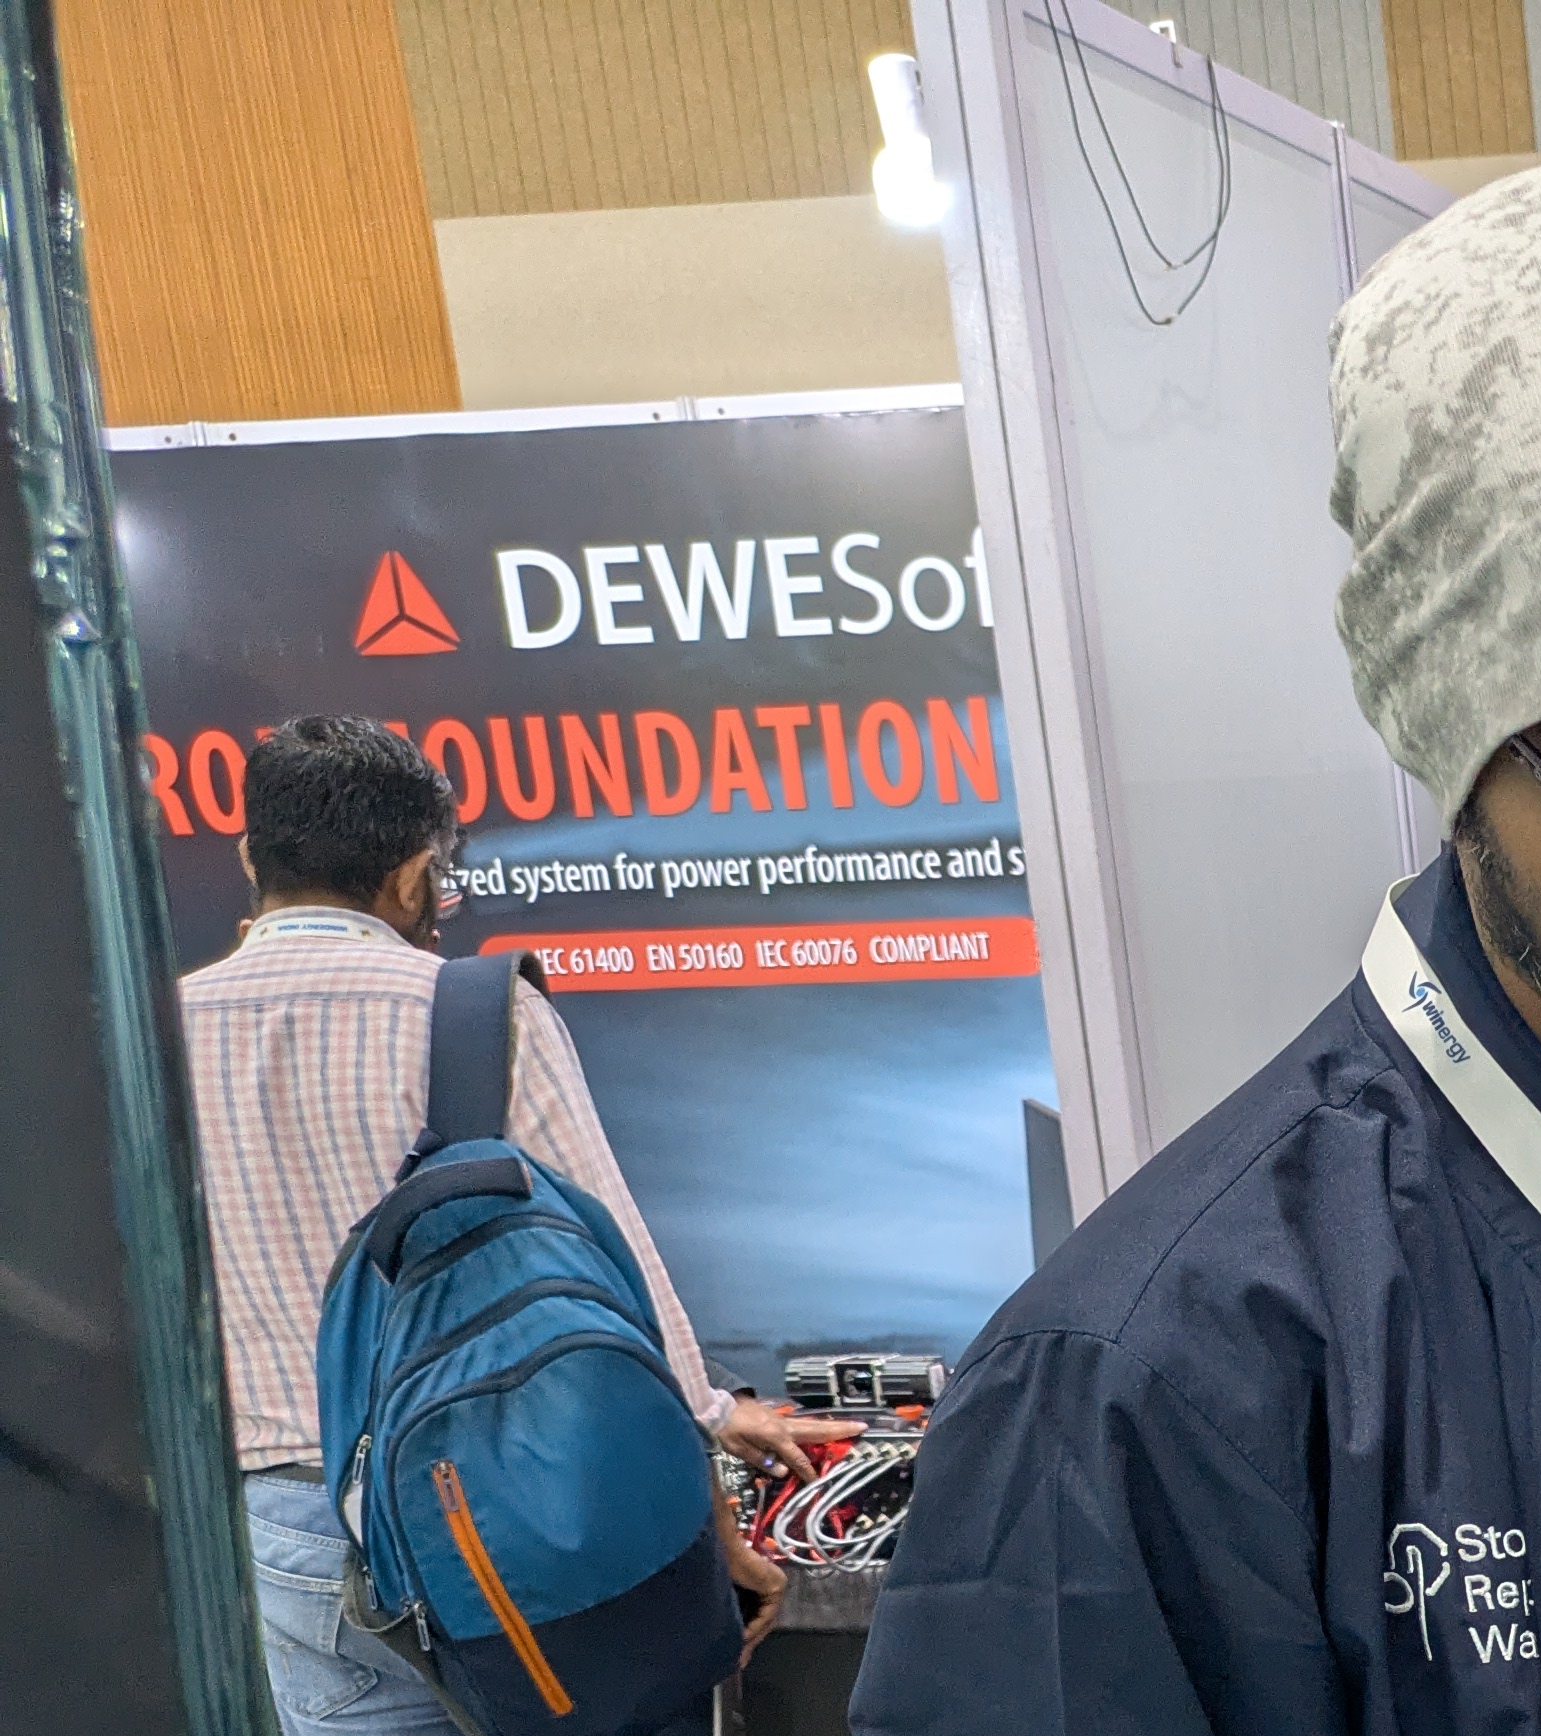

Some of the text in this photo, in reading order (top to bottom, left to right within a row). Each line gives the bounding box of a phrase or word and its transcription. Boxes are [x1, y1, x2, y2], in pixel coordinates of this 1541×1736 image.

[384, 696, 998, 824] OUNDATION
[510, 861, 610, 903] system
[614, 852, 655, 891] for
[661, 855, 751, 898] power
[758, 844, 942, 894] performance
[947, 837, 1004, 878] and
[570, 946, 635, 974] 61400
[647, 944, 677, 971] EN
[681, 942, 744, 971] 50160
[755, 939, 790, 967] IEC
[792, 938, 858, 966] 60076
[869, 932, 990, 964] COMPLIANT
[1422, 1000, 1471, 1064] winergy
[1455, 1523, 1527, 1562] Sto
[1468, 1623, 1540, 1664] Wa
